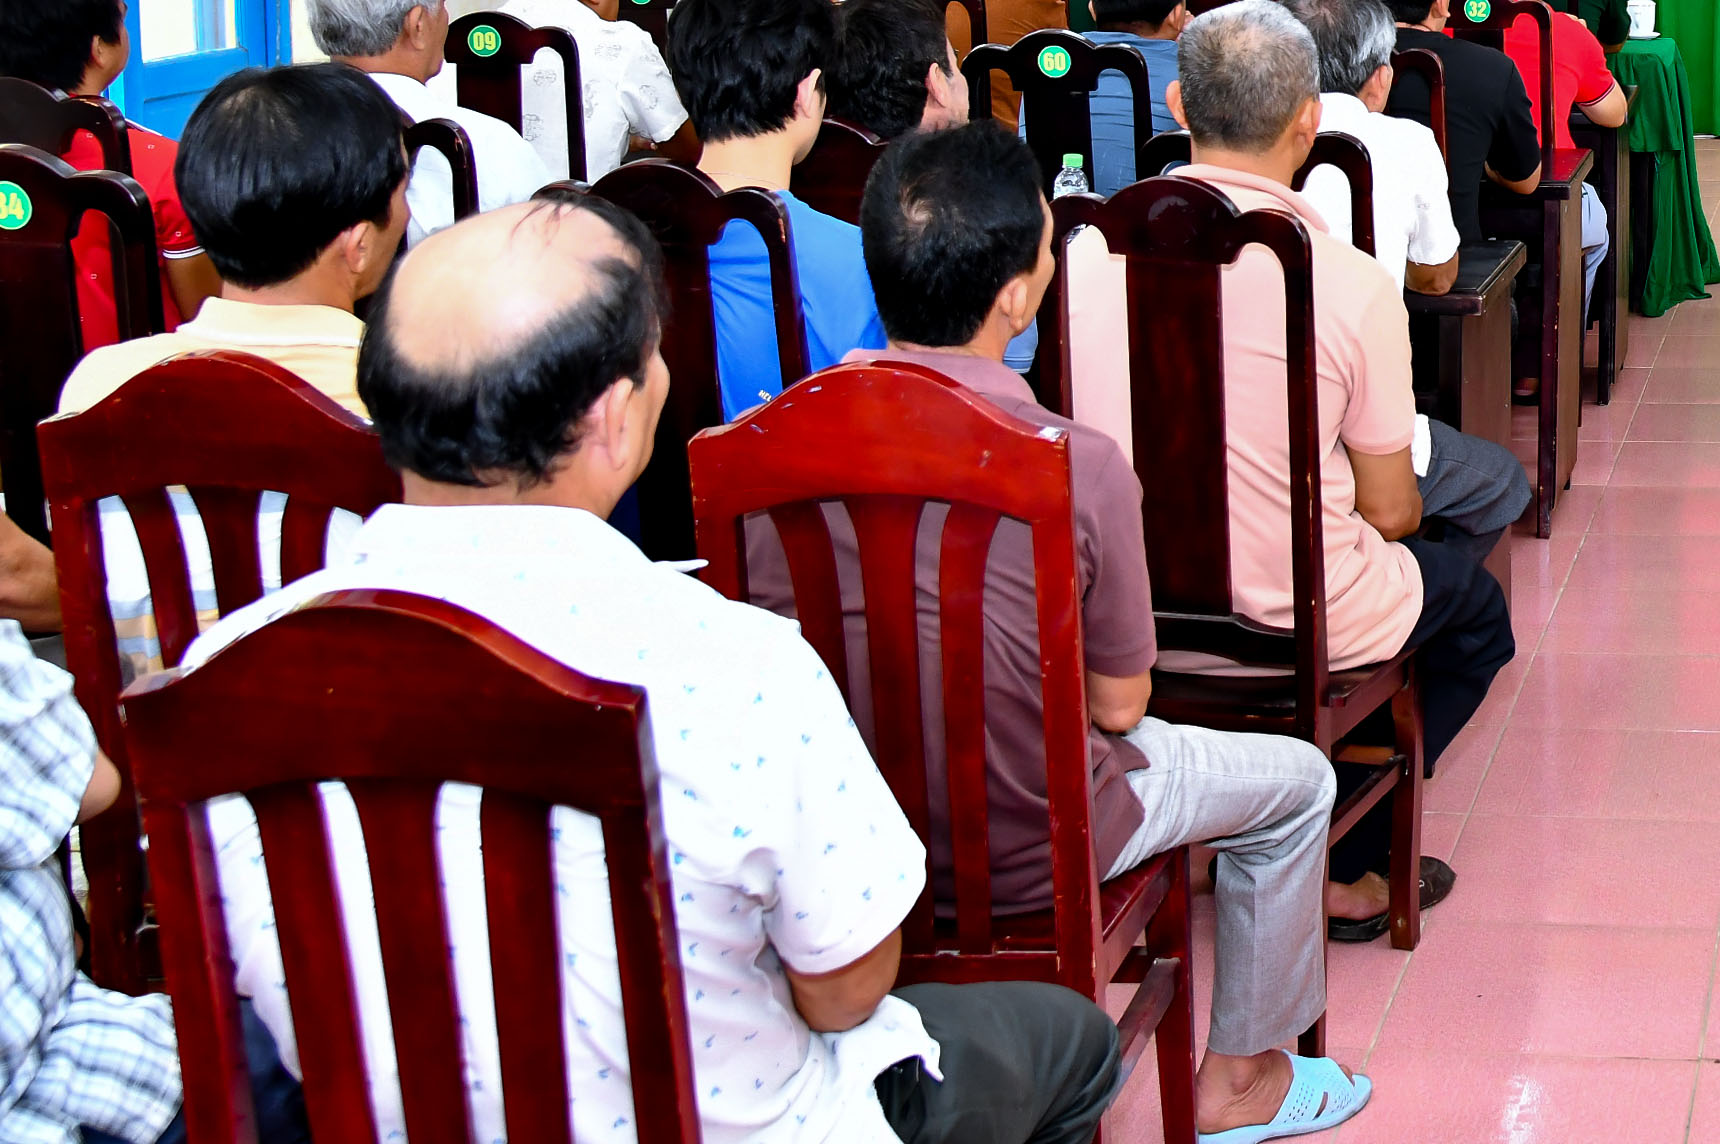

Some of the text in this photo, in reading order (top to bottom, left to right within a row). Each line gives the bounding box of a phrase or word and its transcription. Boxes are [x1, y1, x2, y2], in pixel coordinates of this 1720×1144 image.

[1468, 1, 1487, 18] 32
[473, 31, 497, 51] 09
[1043, 52, 1066, 72] 60
